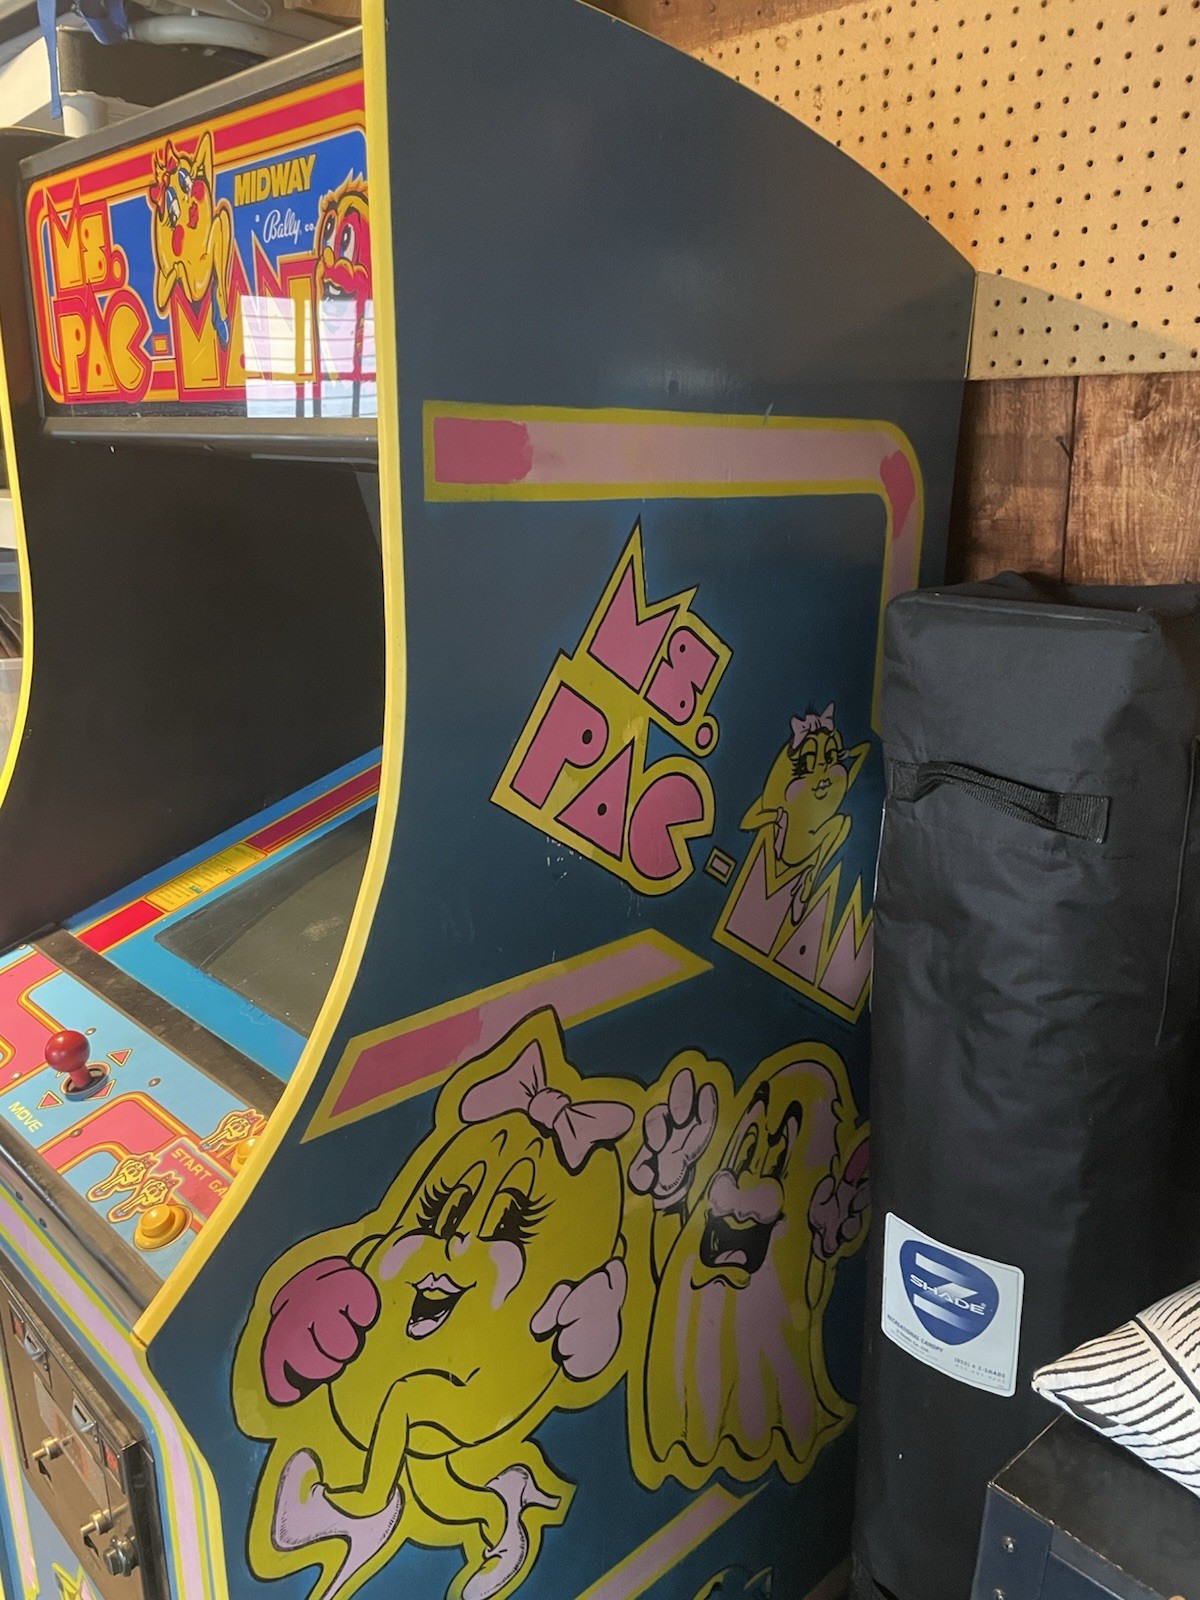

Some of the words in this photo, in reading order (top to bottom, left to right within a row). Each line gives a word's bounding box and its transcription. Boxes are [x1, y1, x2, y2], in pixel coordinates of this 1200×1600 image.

[233, 153, 316, 207] MIDWAY
[263, 208, 301, 245] Bally
[8, 1101, 43, 1133] MOVE
[171, 1148, 212, 1180] START
[208, 1179, 229, 1199] GA
[909, 1274, 986, 1316] SHADE
